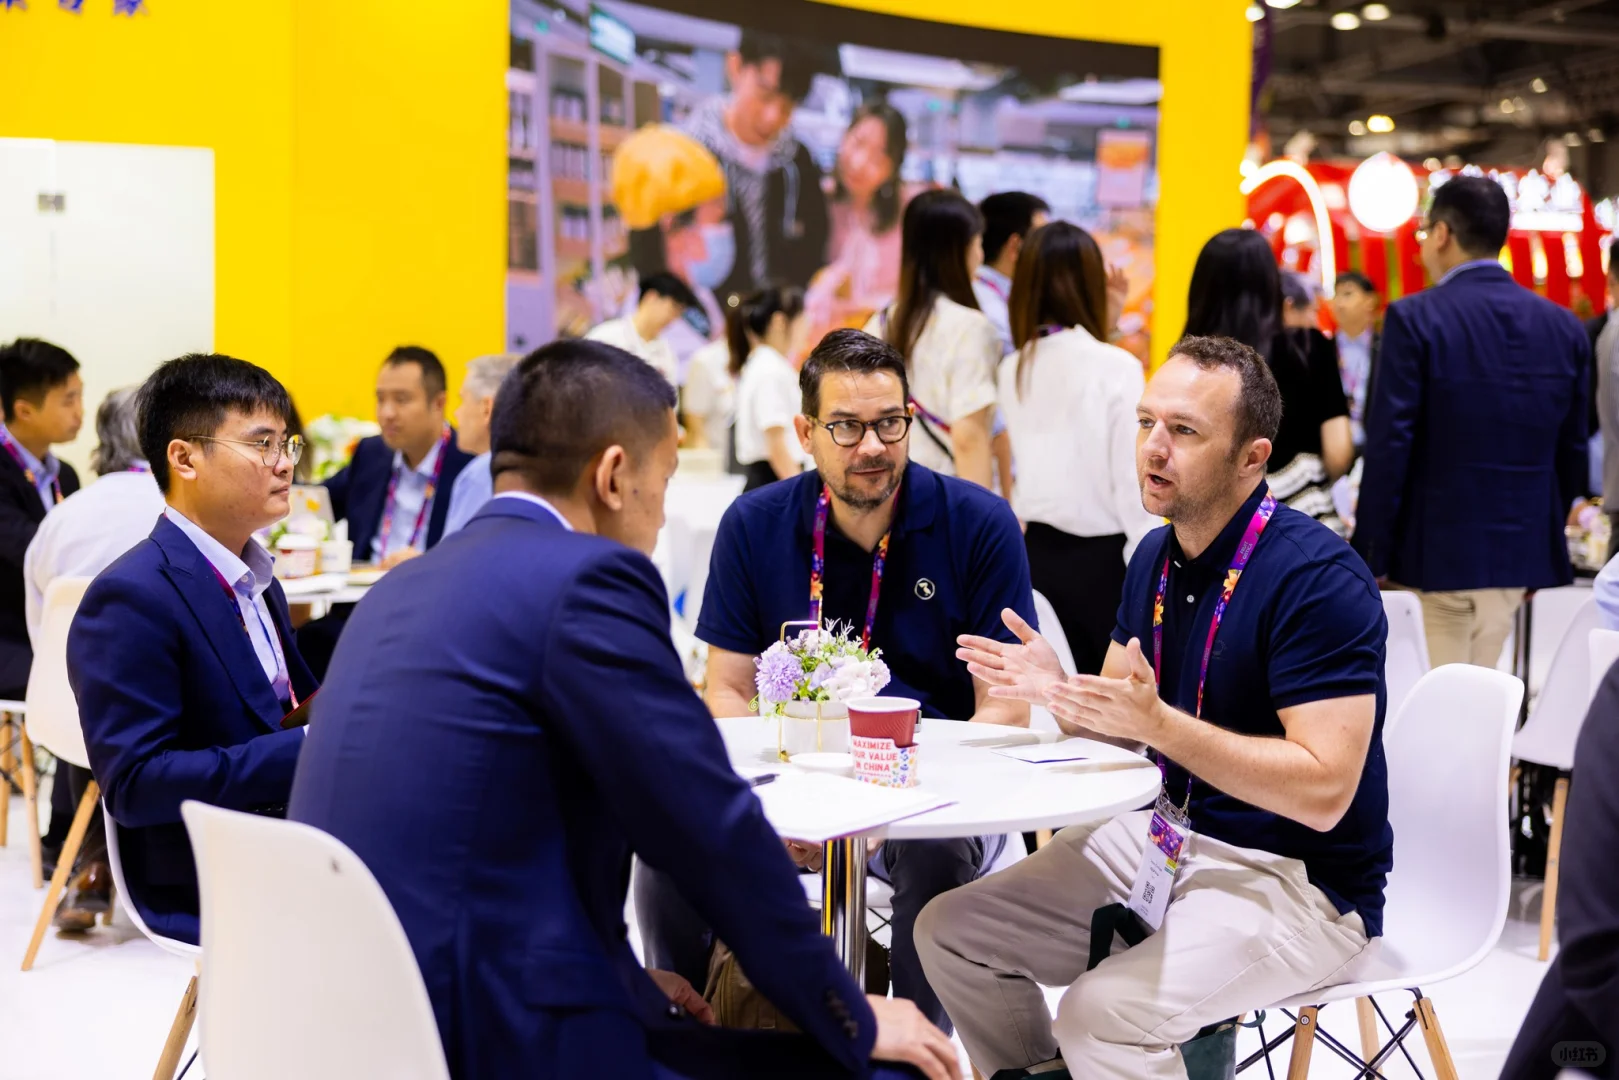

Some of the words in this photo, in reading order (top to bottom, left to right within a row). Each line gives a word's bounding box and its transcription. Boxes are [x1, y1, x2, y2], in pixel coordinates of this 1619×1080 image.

[853, 739, 891, 750] MAXIMIZE
[869, 752, 898, 761] VALUE
[863, 762, 890, 772] CHINA
